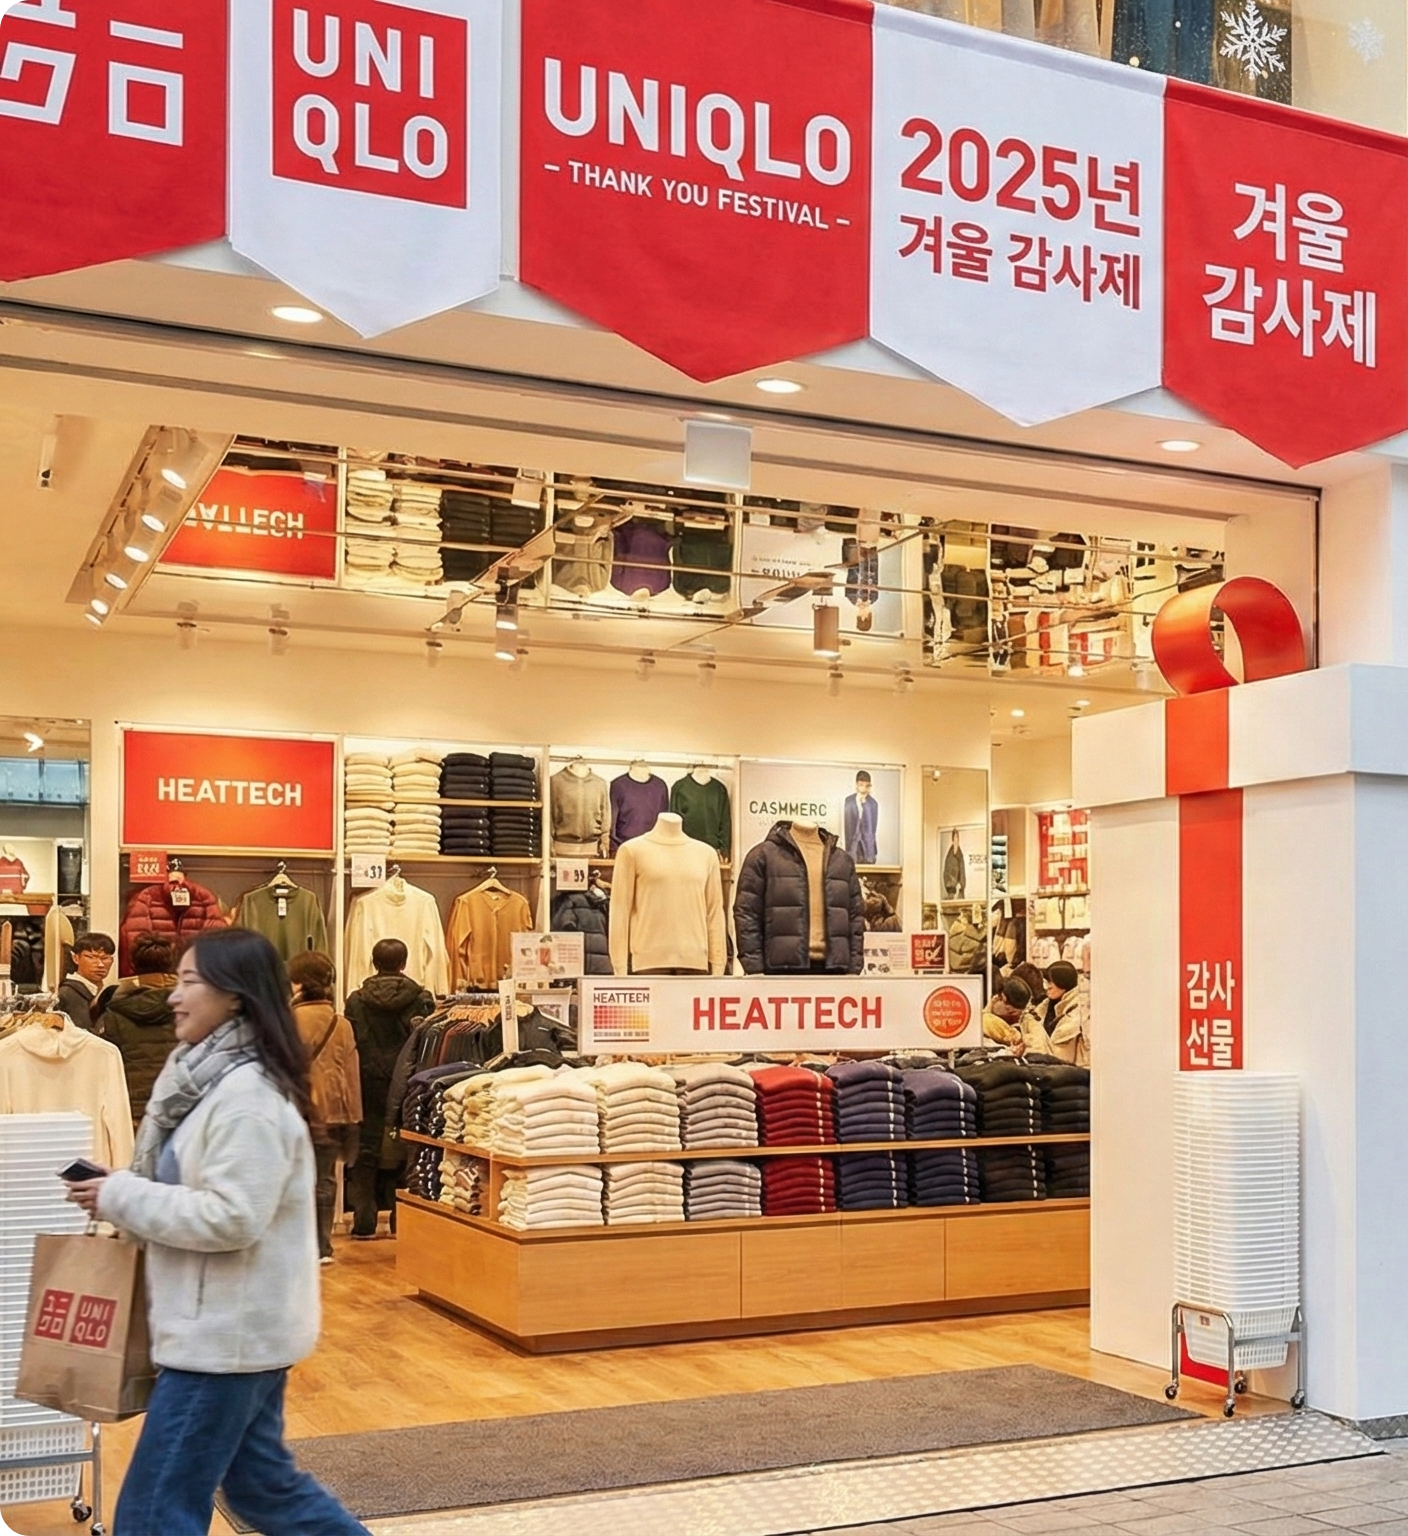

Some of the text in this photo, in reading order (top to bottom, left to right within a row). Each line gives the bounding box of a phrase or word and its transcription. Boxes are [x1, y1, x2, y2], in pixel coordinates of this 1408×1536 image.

[292, 8, 434, 99] UNI
[293, 95, 449, 179] QLO
[544, 57, 851, 186] UNIQLO
[568, 160, 653, 197] THANK
[662, 179, 708, 207] YOU
[718, 189, 829, 229] FESTIVAL
[899, 117, 1141, 237] 2025년
[898, 213, 1141, 310] 겨울 감사제
[1233, 181, 1349, 273] 겨울
[1201, 263, 1377, 368] 감사제
[158, 777, 302, 807] HEATTECH
[693, 996, 882, 1030] HEATTECH
[1186, 960, 1235, 1011] 감사
[1186, 1018, 1234, 1067] 선물
[74, 1321, 107, 1342] QLO
[81, 1302, 110, 1320] UNI
